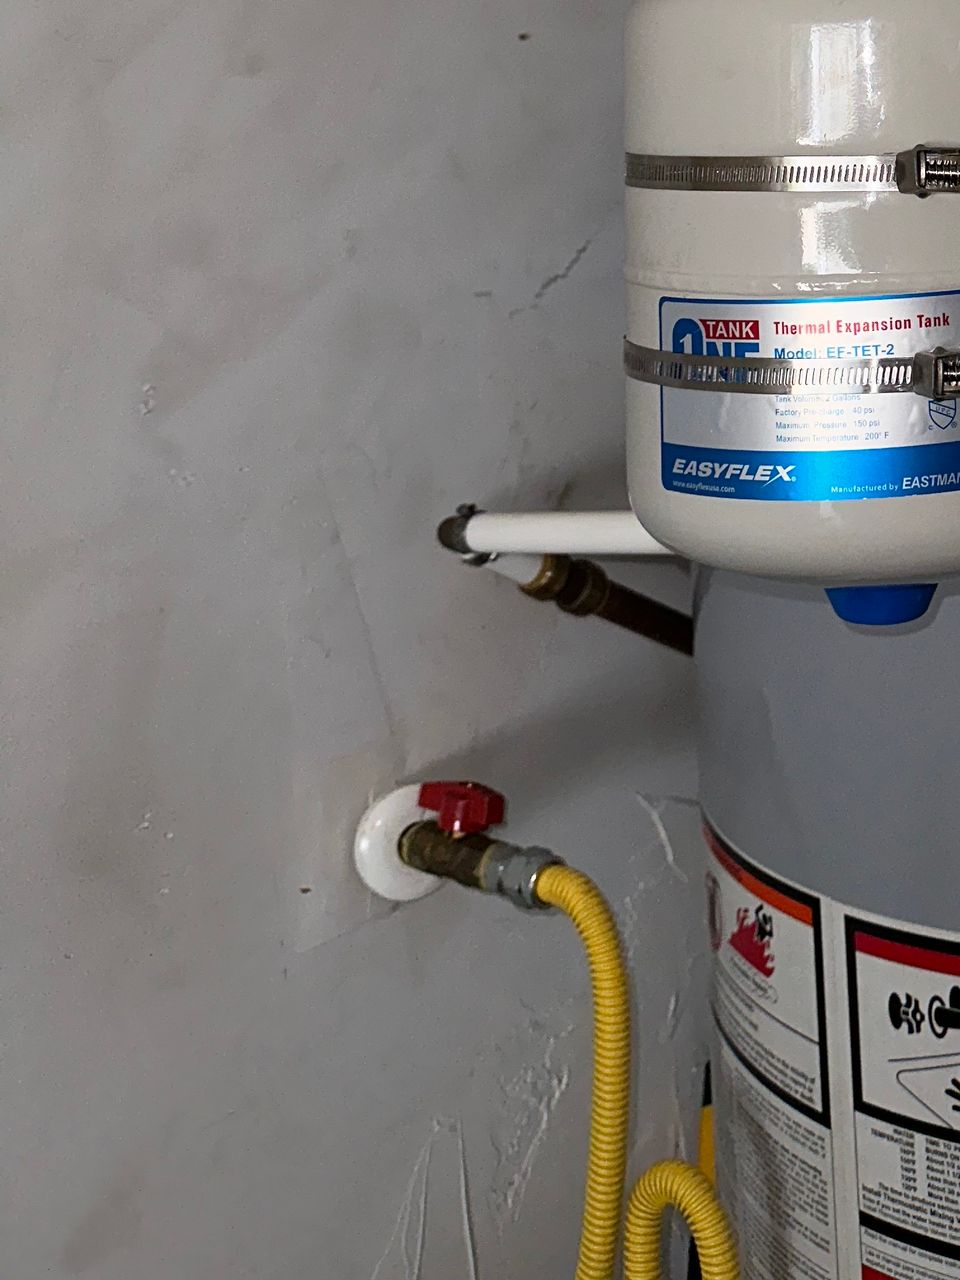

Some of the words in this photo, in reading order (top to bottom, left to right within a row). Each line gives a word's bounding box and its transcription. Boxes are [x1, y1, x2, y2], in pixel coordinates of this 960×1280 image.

[707, 321, 754, 338] TANK
[773, 320, 830, 335] Thermal
[836, 317, 911, 335] Expansion
[916, 313, 950, 329] Tank
[826, 344, 894, 359] EF-TET-2
[868, 419, 880, 430] psi
[672, 458, 796, 485] EASYFLEX
[831, 483, 887, 494] Manufactured
[889, 483, 898, 492] by
[930, 1208, 954, 1224] Mixing
